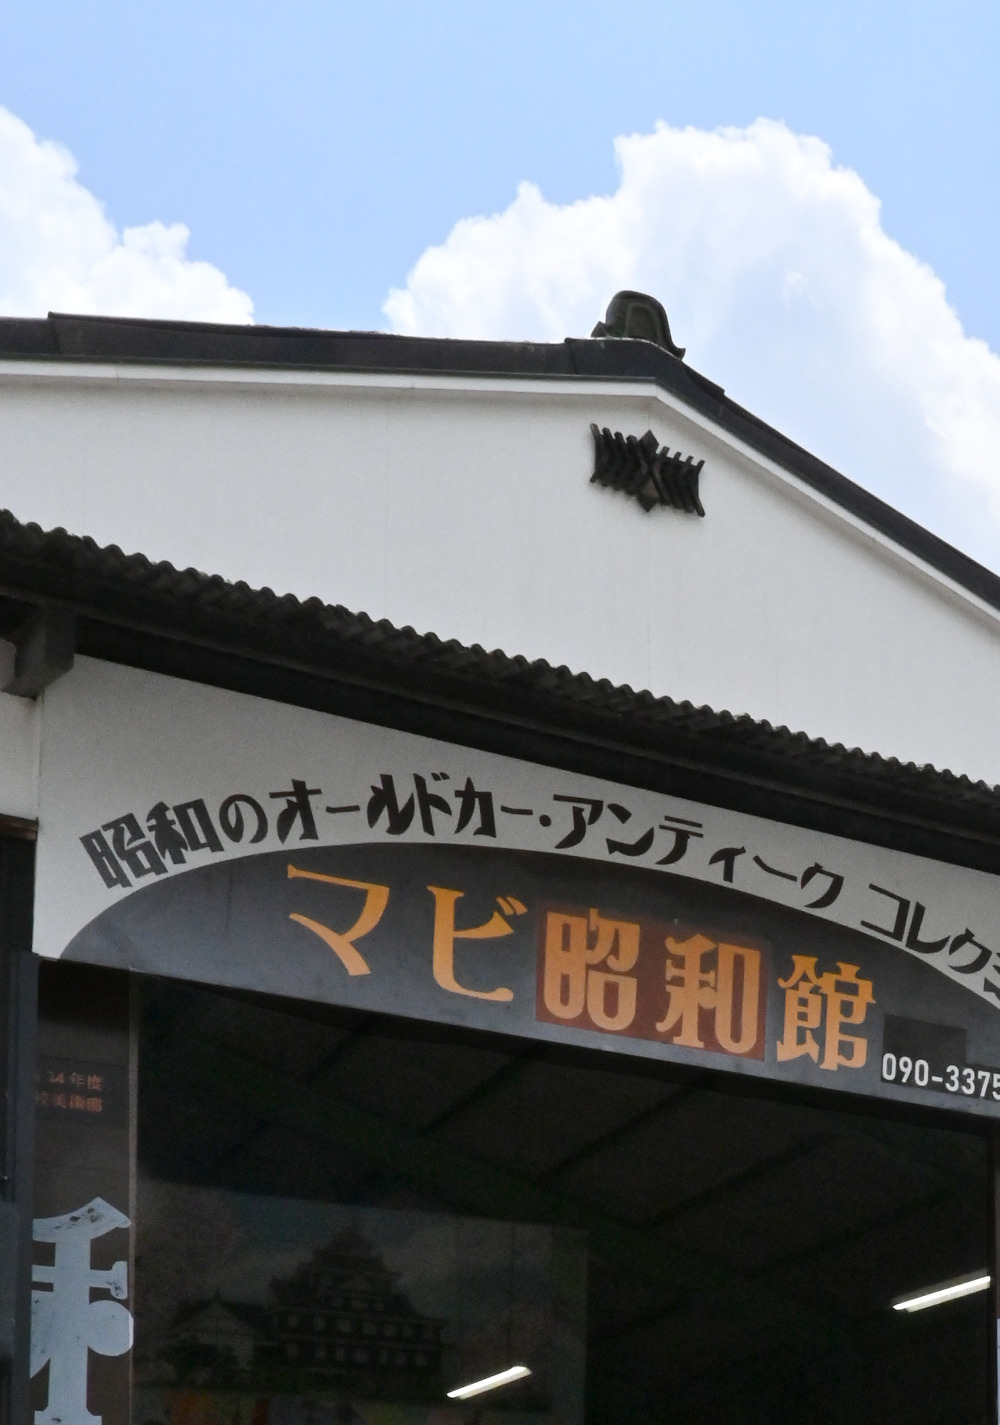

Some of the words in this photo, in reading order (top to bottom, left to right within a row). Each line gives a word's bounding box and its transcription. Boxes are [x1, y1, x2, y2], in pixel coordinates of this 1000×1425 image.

[287, 863, 876, 1071] マビ昭和館
